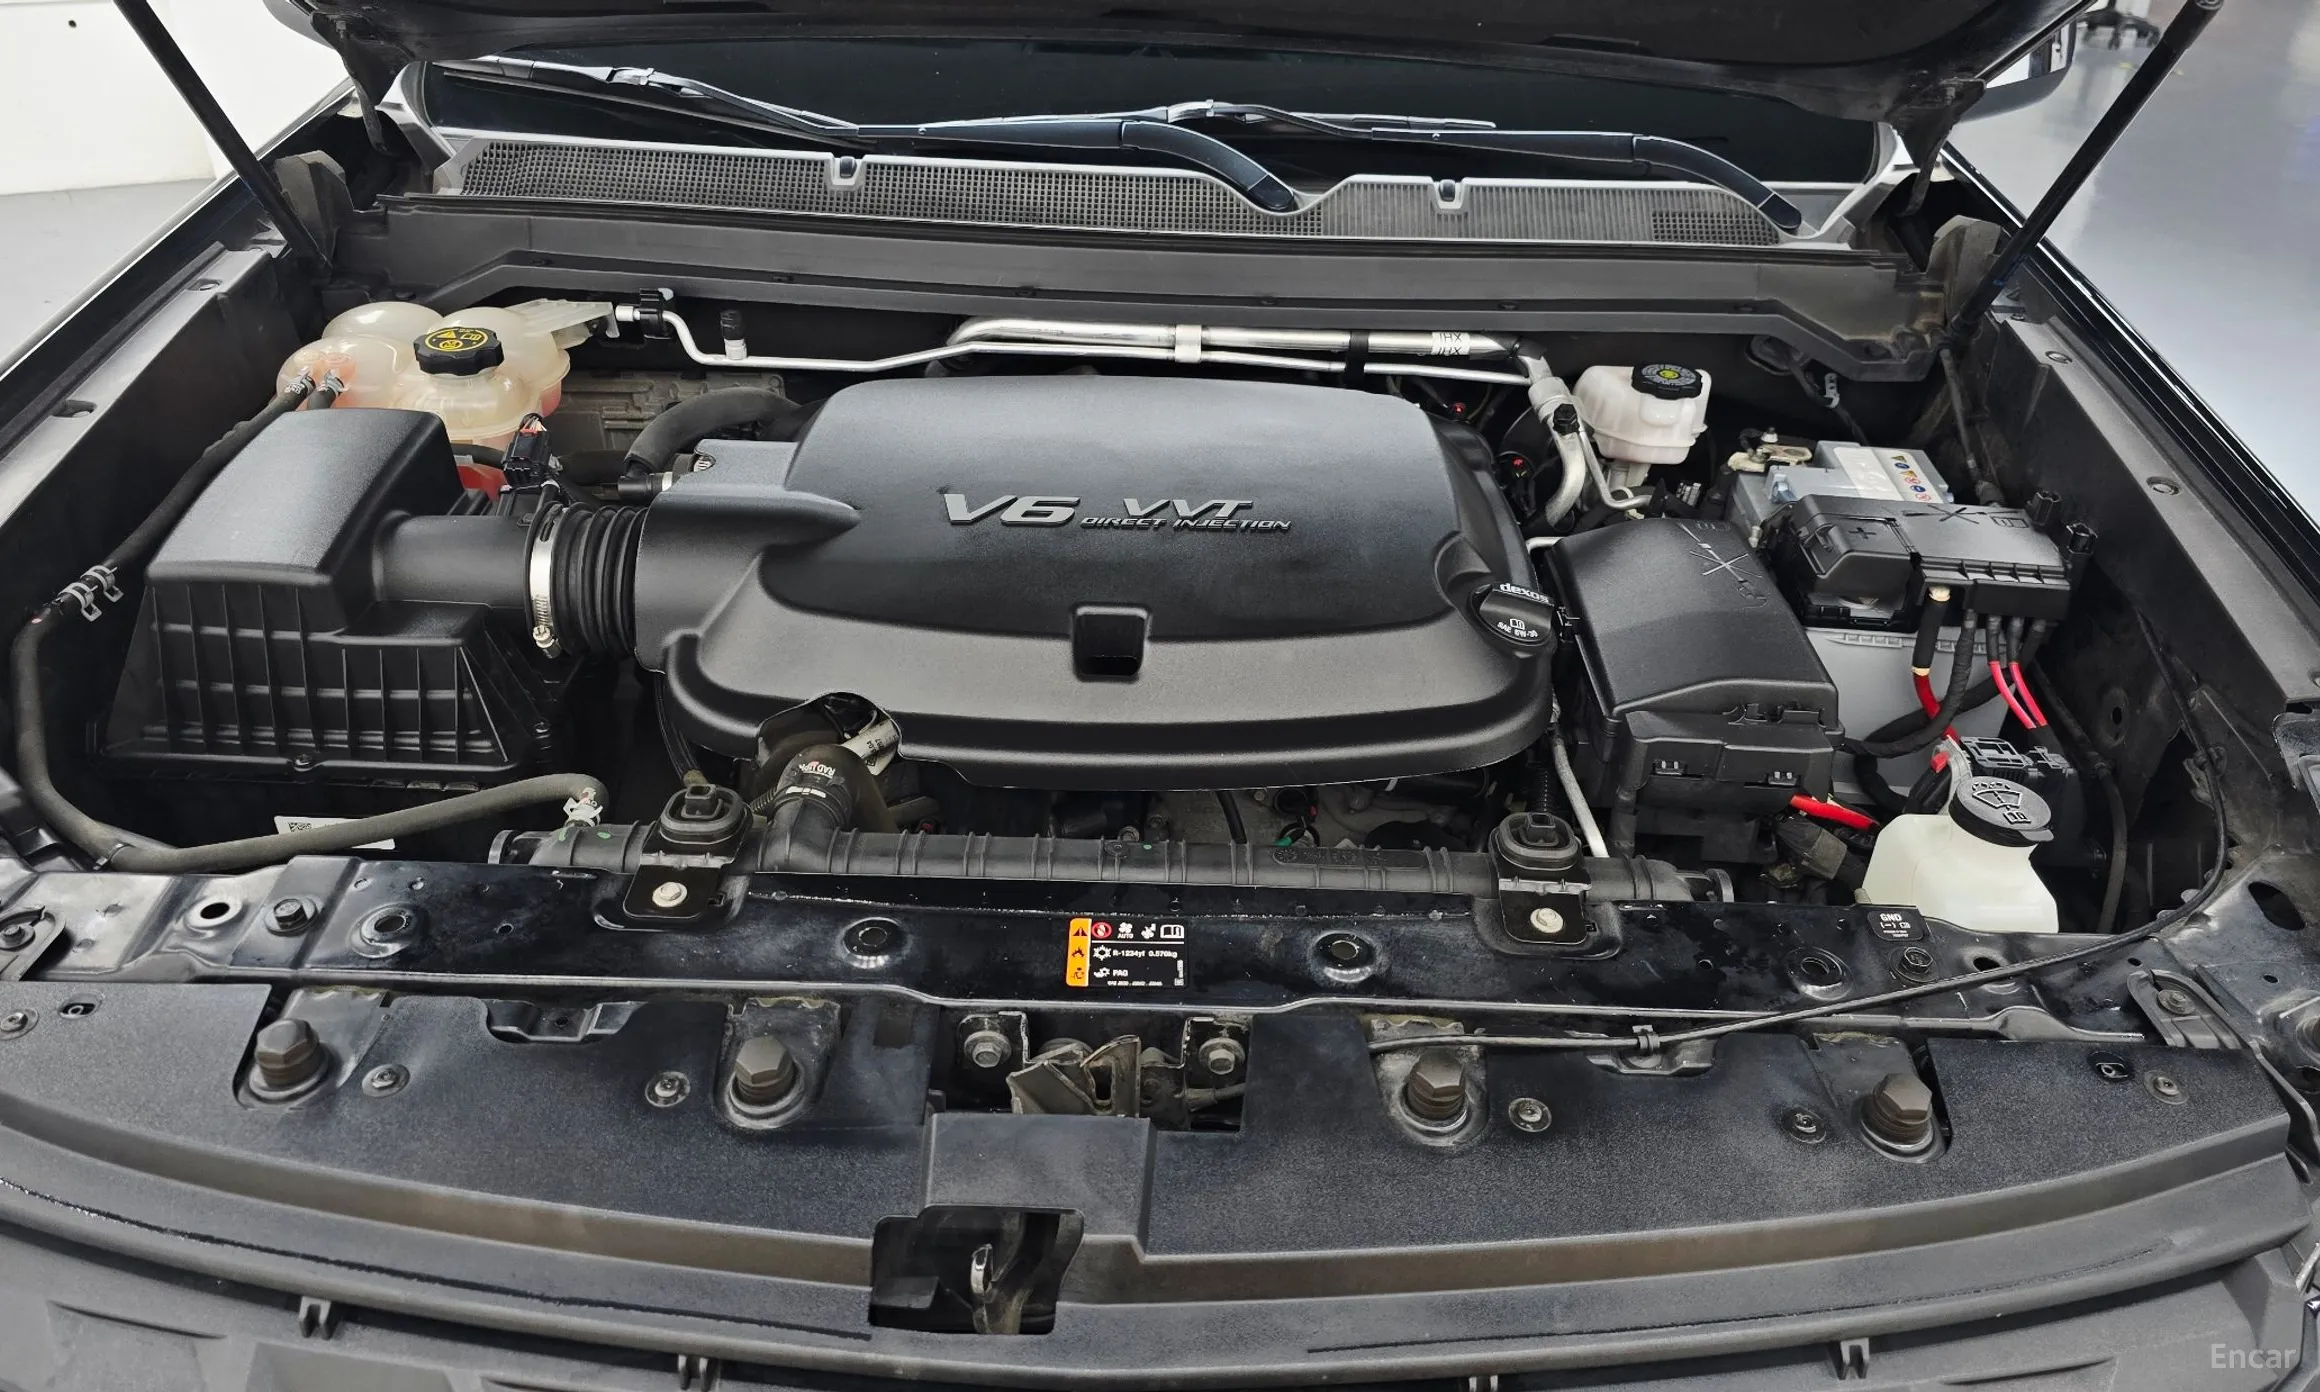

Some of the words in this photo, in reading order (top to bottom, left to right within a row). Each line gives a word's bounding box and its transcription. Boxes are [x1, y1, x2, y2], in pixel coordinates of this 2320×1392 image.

[943, 493, 1081, 527] V6
[1123, 498, 1254, 519] VVT
[1080, 516, 1167, 529] DIRECT
[1172, 517, 1293, 533] INJECTION
[1500, 583, 1549, 603] dexos
[817, 764, 835, 777] RAD
[1879, 913, 1903, 922] GND
[1112, 949, 1145, 958] R-1234yf
